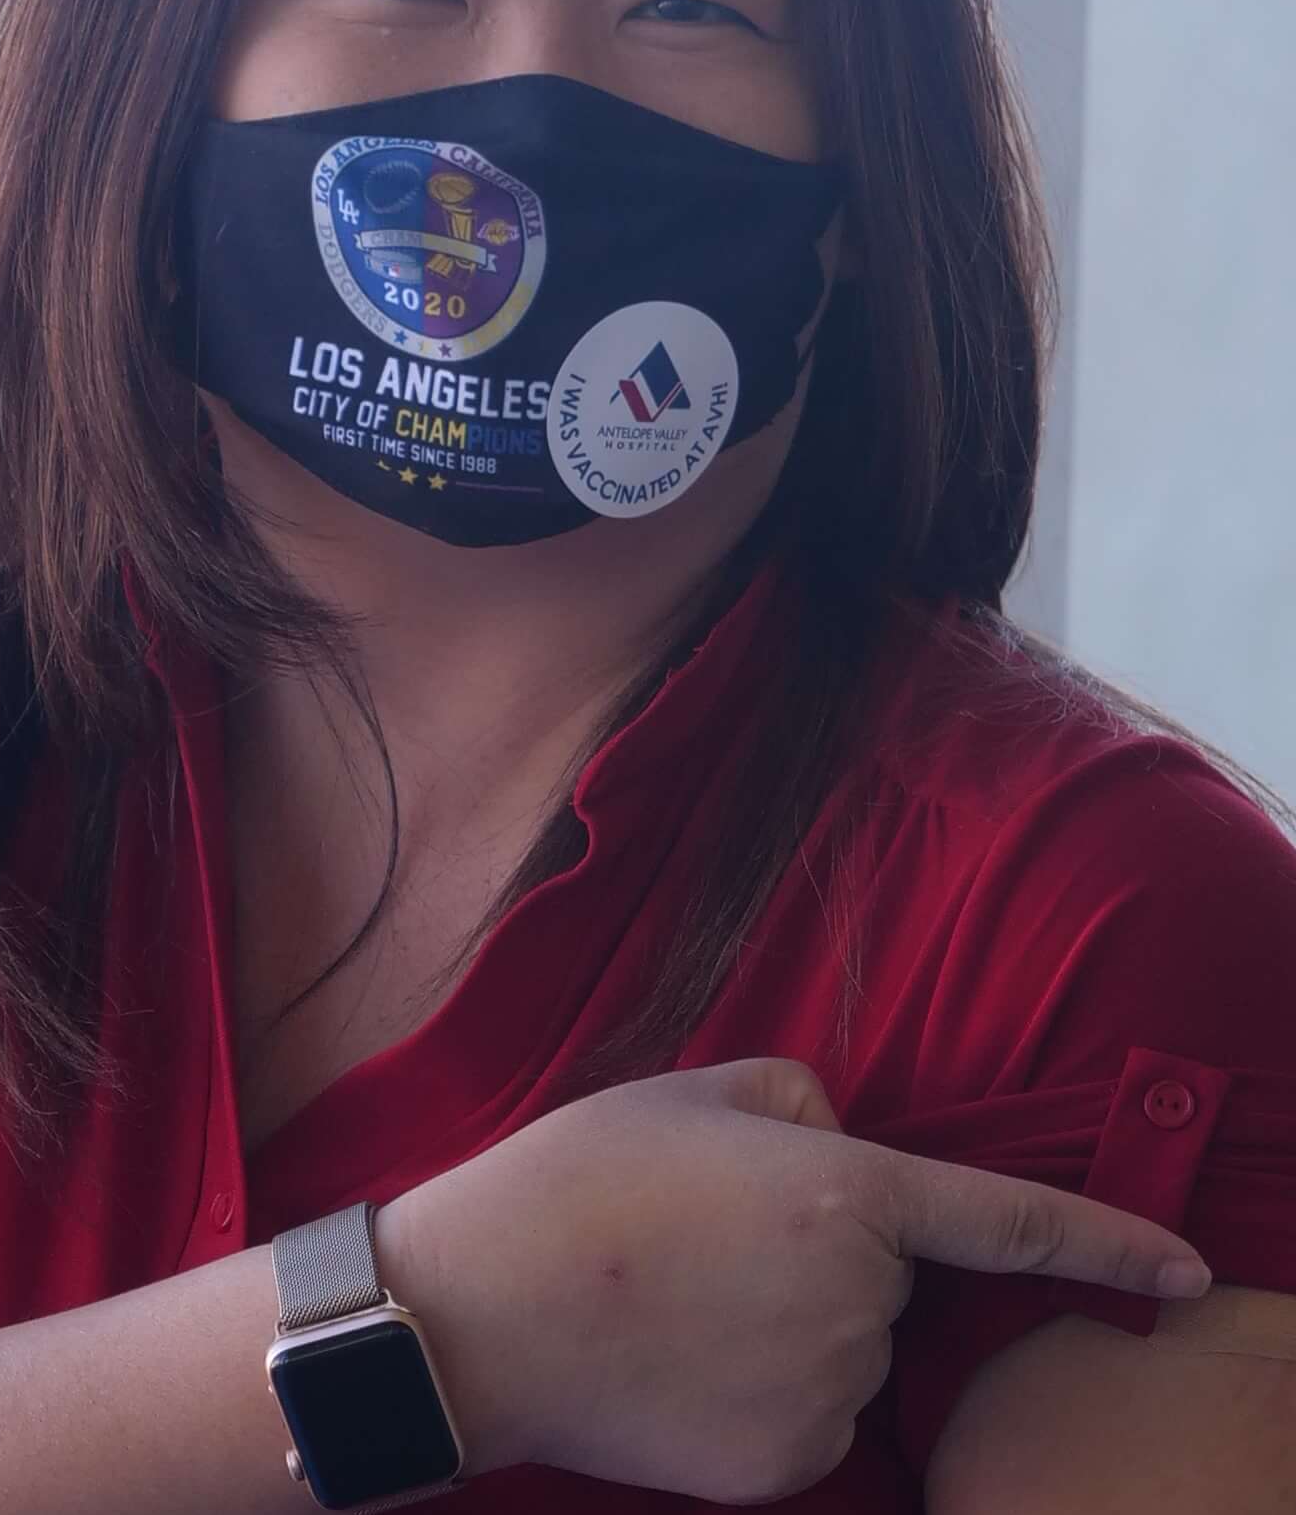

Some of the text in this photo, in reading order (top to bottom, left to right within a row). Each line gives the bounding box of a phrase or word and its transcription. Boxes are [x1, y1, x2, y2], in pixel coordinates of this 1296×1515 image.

[316, 164, 335, 207] LOS
[318, 222, 387, 334] DODGERS
[384, 281, 466, 318] 2020
[289, 336, 551, 420] LOS ANGELES
[292, 386, 543, 455] CITY OF CHAMPIONS
[560, 373, 728, 504] I WAS VACCINATED AT AVH!
[597, 426, 688, 439] ANTELOPE VALLEY
[323, 423, 497, 474] FIRST TIME SINCE 1988
[605, 442, 677, 452] HOSPITAL
